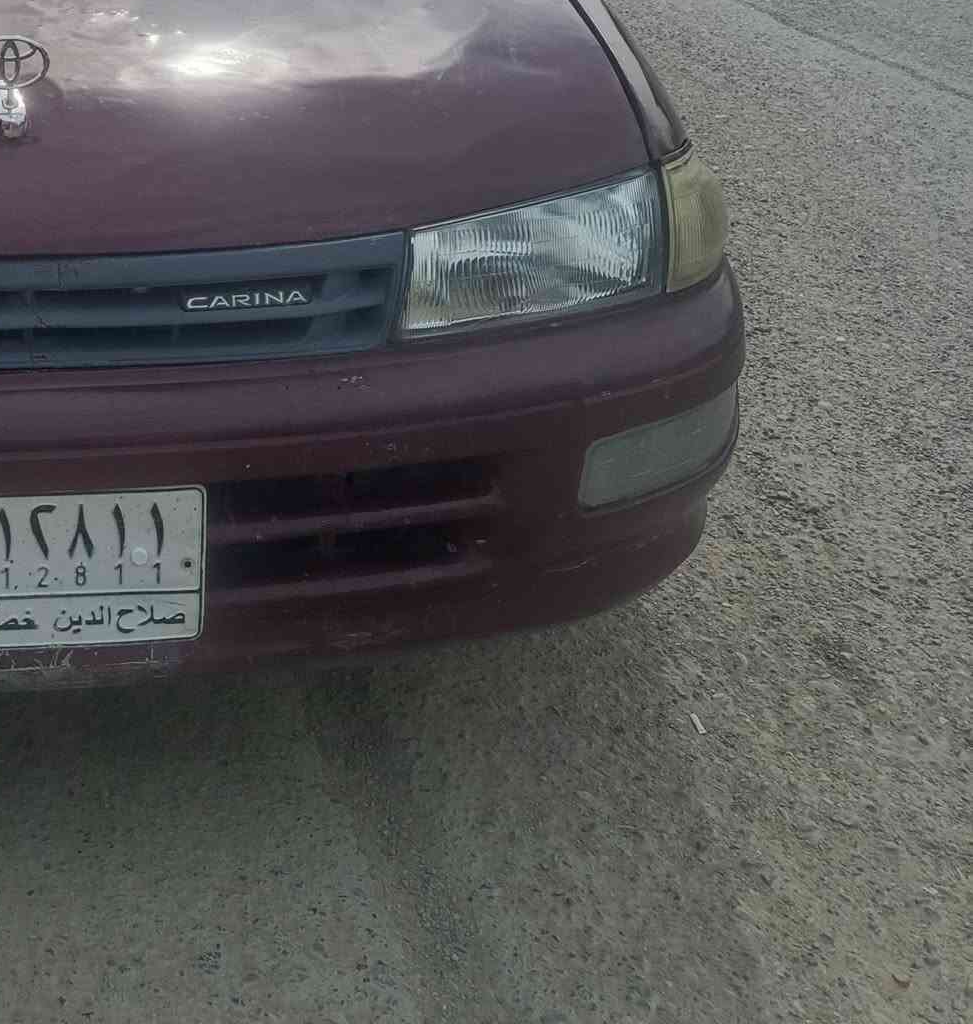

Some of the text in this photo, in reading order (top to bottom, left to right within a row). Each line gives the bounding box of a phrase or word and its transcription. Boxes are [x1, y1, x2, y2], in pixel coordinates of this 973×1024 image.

[186, 290, 307, 309] CARINA
[52, 605, 112, 634] الدين
[115, 604, 187, 634] صلاح
